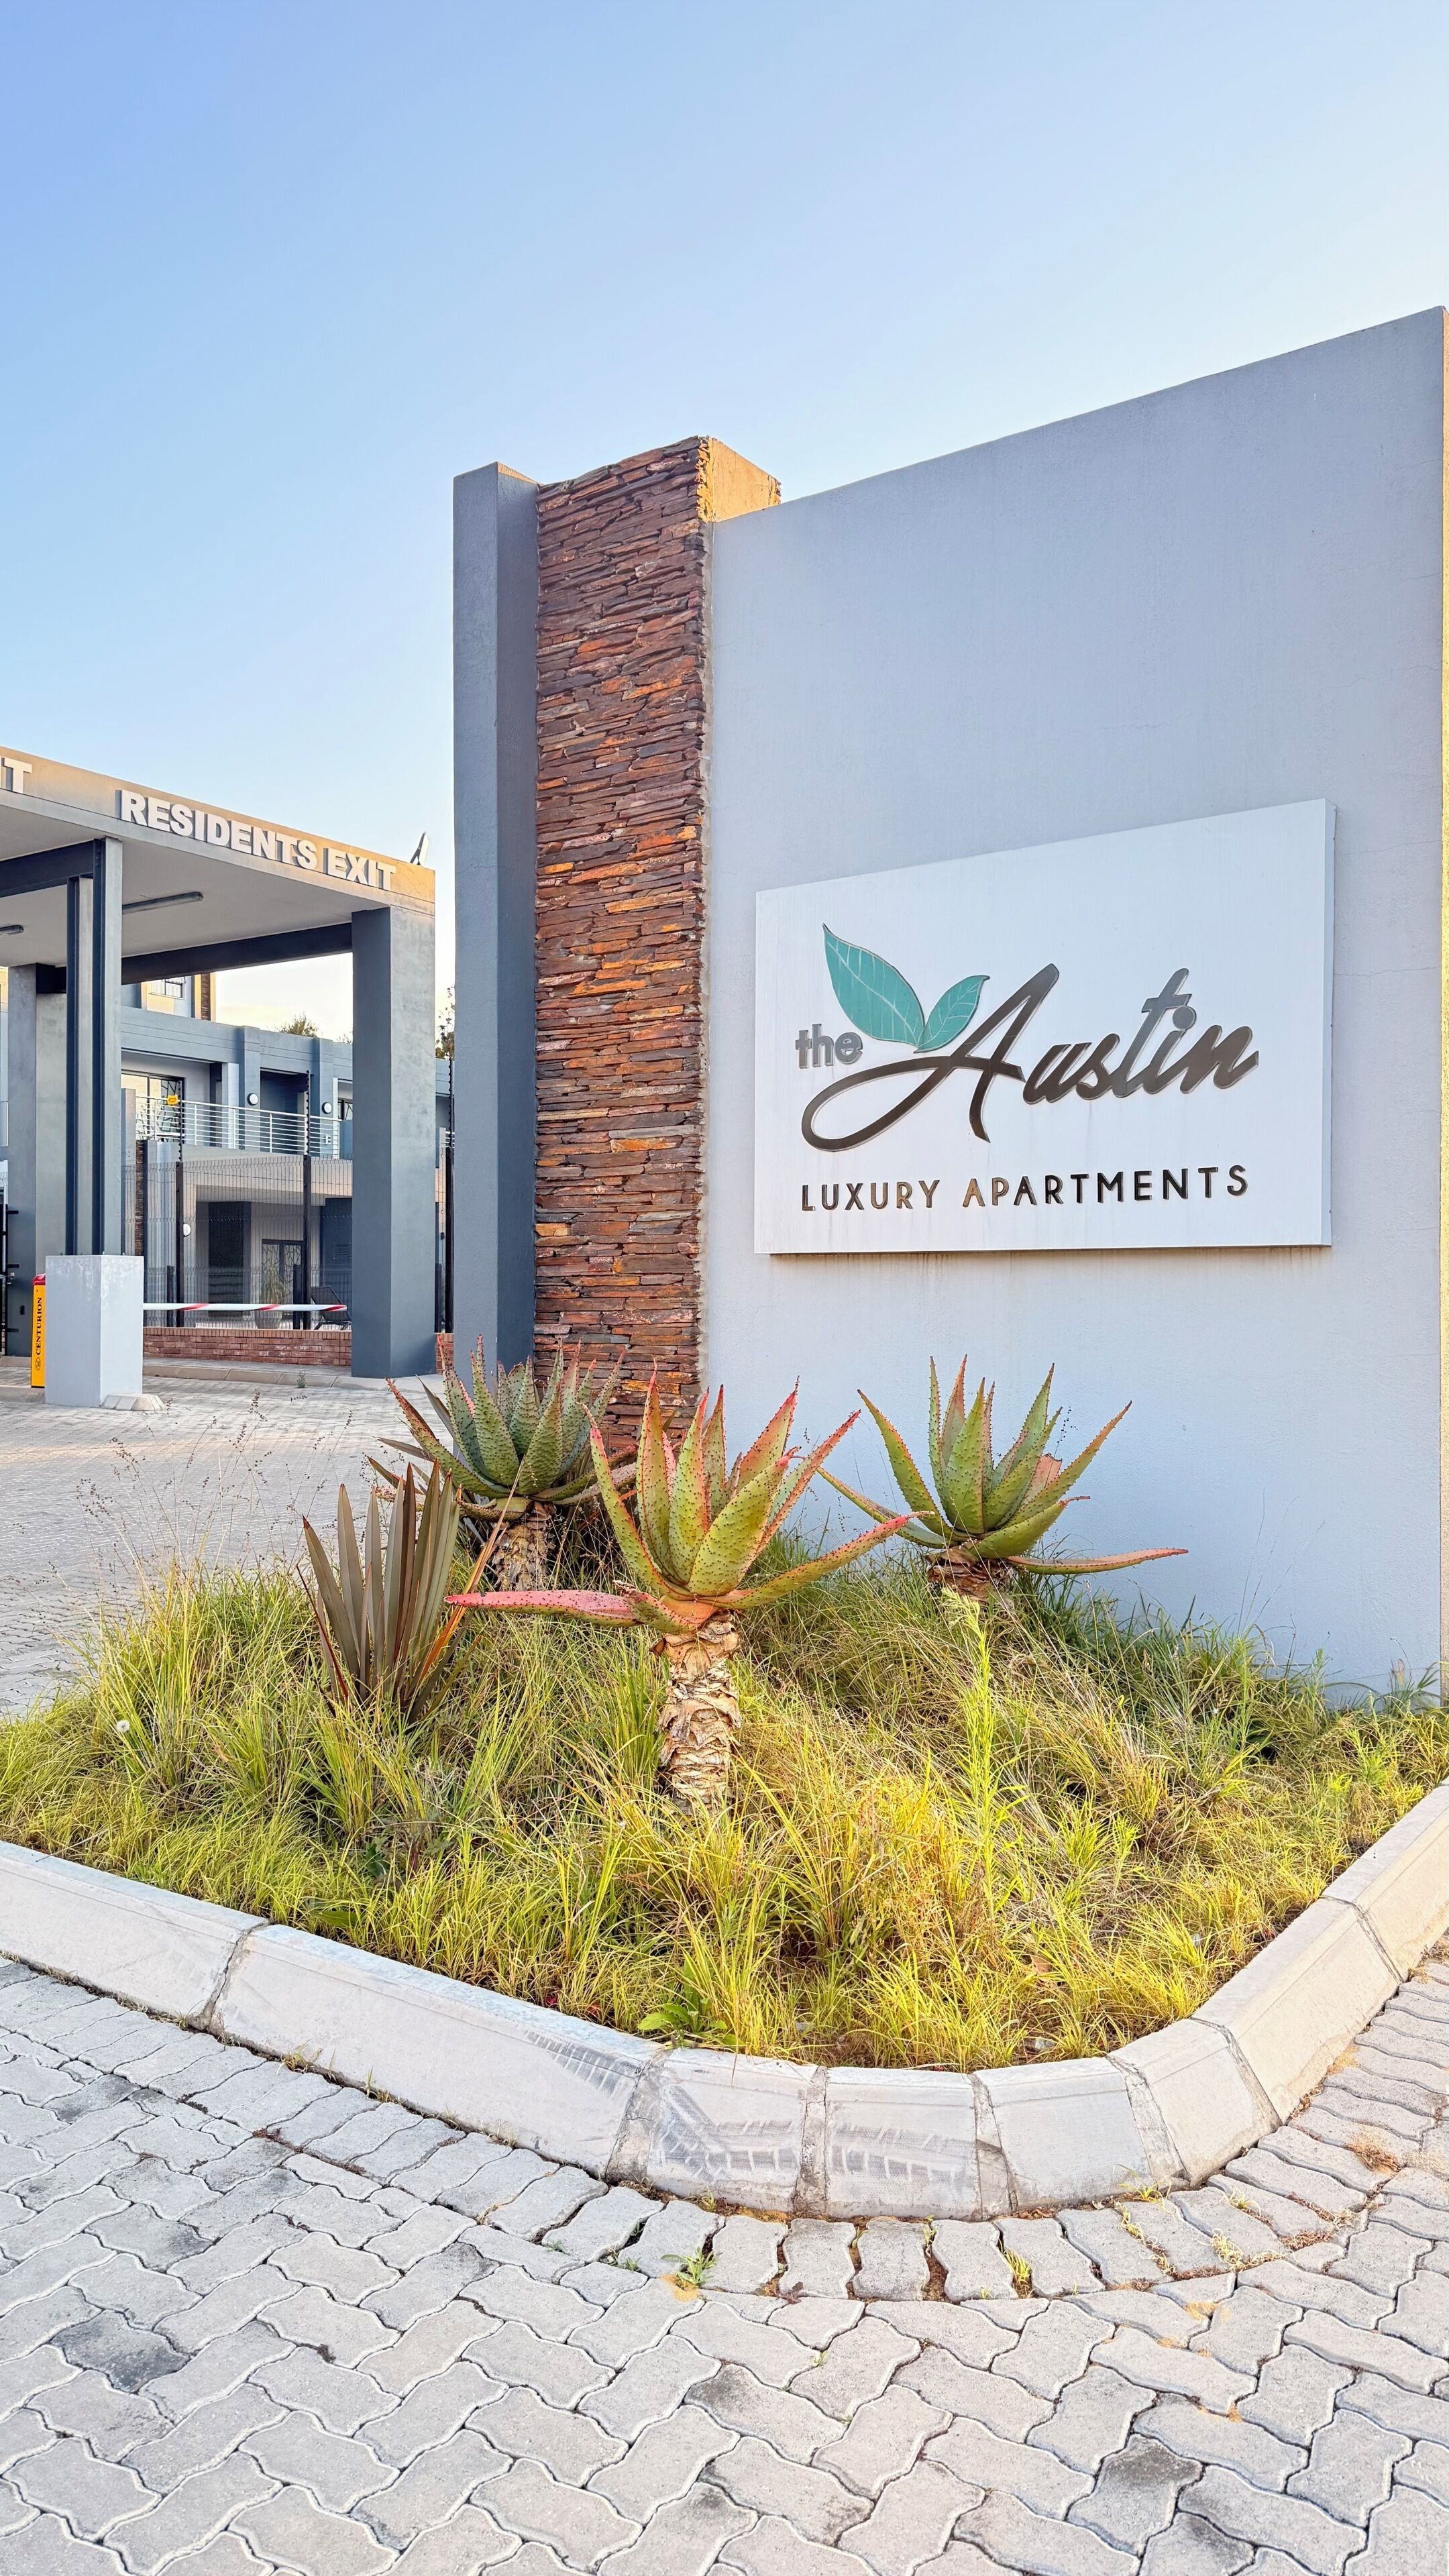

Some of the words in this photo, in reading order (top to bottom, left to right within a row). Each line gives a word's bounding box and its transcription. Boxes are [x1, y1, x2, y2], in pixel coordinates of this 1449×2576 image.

[0, 756, 32, 793] T
[121, 789, 318, 871] RESIDENTS
[327, 847, 396, 891] EXIT
[794, 1023, 863, 1070] the
[801, 963, 1260, 1152] Austin
[801, 1179, 941, 1212] LUXURY
[961, 1165, 1249, 1208] APARTMENTS
